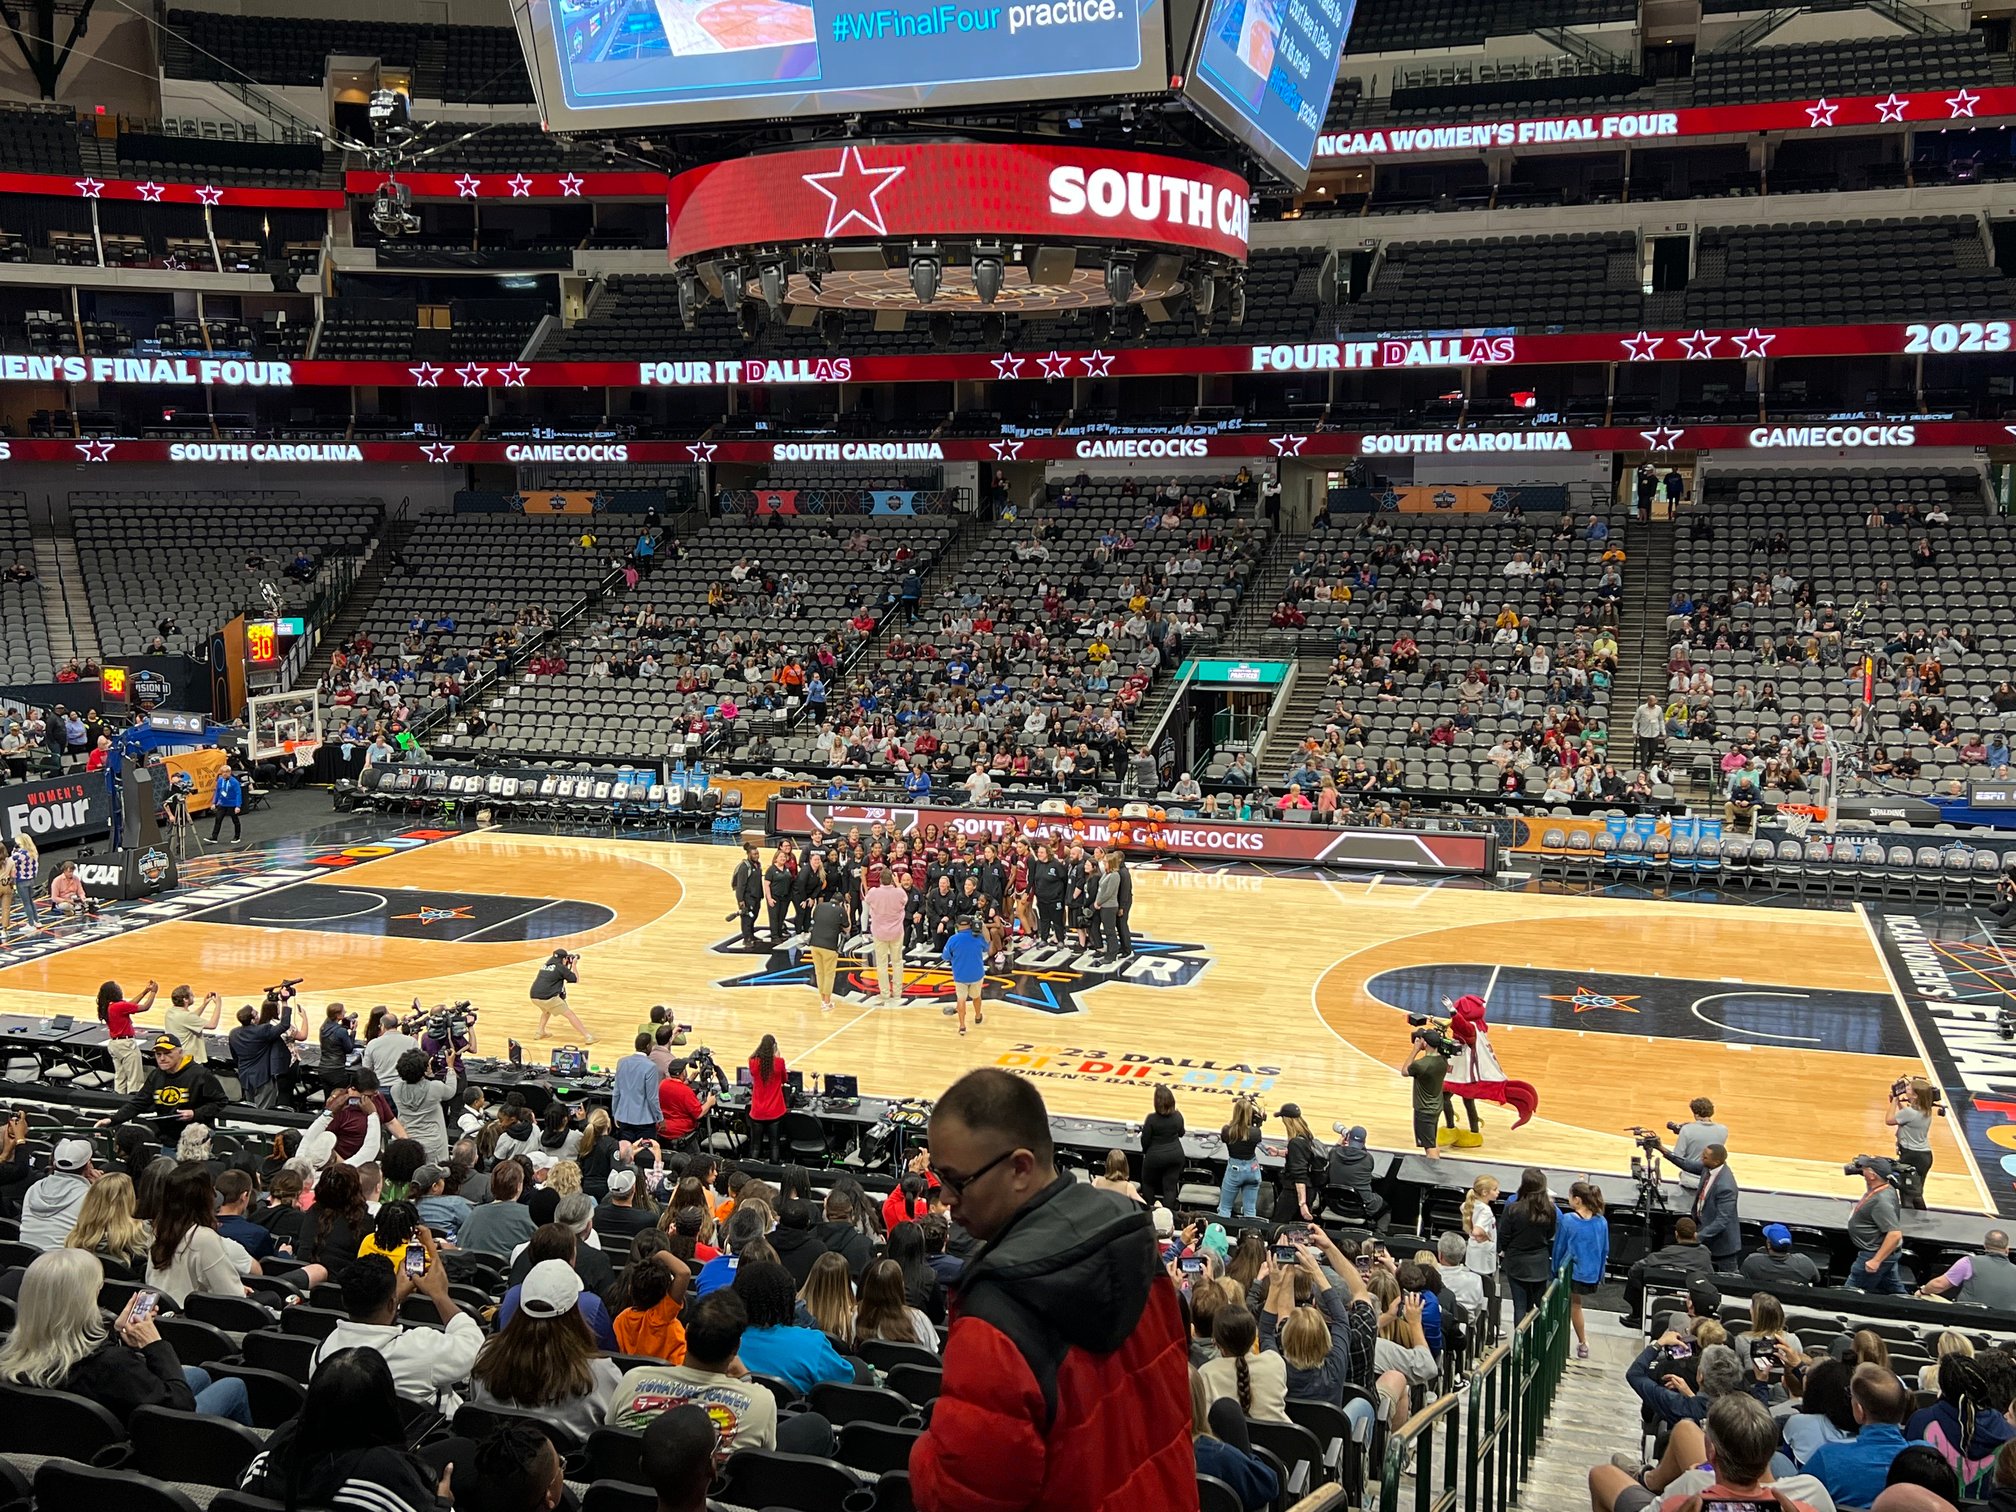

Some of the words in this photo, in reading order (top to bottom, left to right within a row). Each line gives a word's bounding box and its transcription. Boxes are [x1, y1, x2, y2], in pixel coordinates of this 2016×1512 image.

[832, 5, 1001, 43] #WFinalFour
[1008, 0, 1124, 34] practice.
[1318, 131, 1387, 156] NCAA
[1389, 122, 1516, 151] WOMEN'S
[1518, 117, 1599, 143] FINAL
[1602, 113, 1678, 138] FOUR
[1049, 165, 1213, 229] SOUTH
[1904, 322, 2012, 355] 2023
[1251, 344, 1340, 371] FOUR
[1345, 342, 1378, 368] IT
[1383, 337, 1515, 366] DALLAS
[0, 355, 87, 381] EN'S
[92, 357, 196, 384] FINAL
[200, 359, 293, 386] FOUR
[640, 361, 712, 385] FOUR
[715, 361, 742, 383] IT
[746, 358, 851, 383] DALLAS
[1076, 438, 1208, 457] GAMECOCKS
[1361, 433, 1444, 454] SOUTH
[1446, 431, 1573, 451] CAROLINA
[1749, 425, 1915, 448] GAMECOCKS
[170, 443, 248, 461] SOUTH
[251, 443, 363, 461] CAROLINA
[505, 444, 628, 462] GAMECOCKS
[773, 443, 841, 461] SOUTH
[842, 442, 944, 460] CAROLINA
[252, 637, 272, 660] 30
[417, 769, 446, 777] DALLAS
[27, 784, 84, 806] WOMEN'S
[1976, 791, 2006, 800] ESPN
[8, 797, 90, 839] Four
[1869, 808, 1906, 817] SPALDING
[1835, 836, 1879, 845] DALLAS
[126, 867, 331, 916] FINAL
[305, 829, 463, 866] FOUR
[1883, 914, 1928, 941] NCAA
[1077, 1060, 1153, 1078] DII
[1120, 1053, 1281, 1076] DALLAS
[1104, 1077, 1265, 1099] BASKETBALL
[635, 1378, 703, 1399] SIGNATURE
